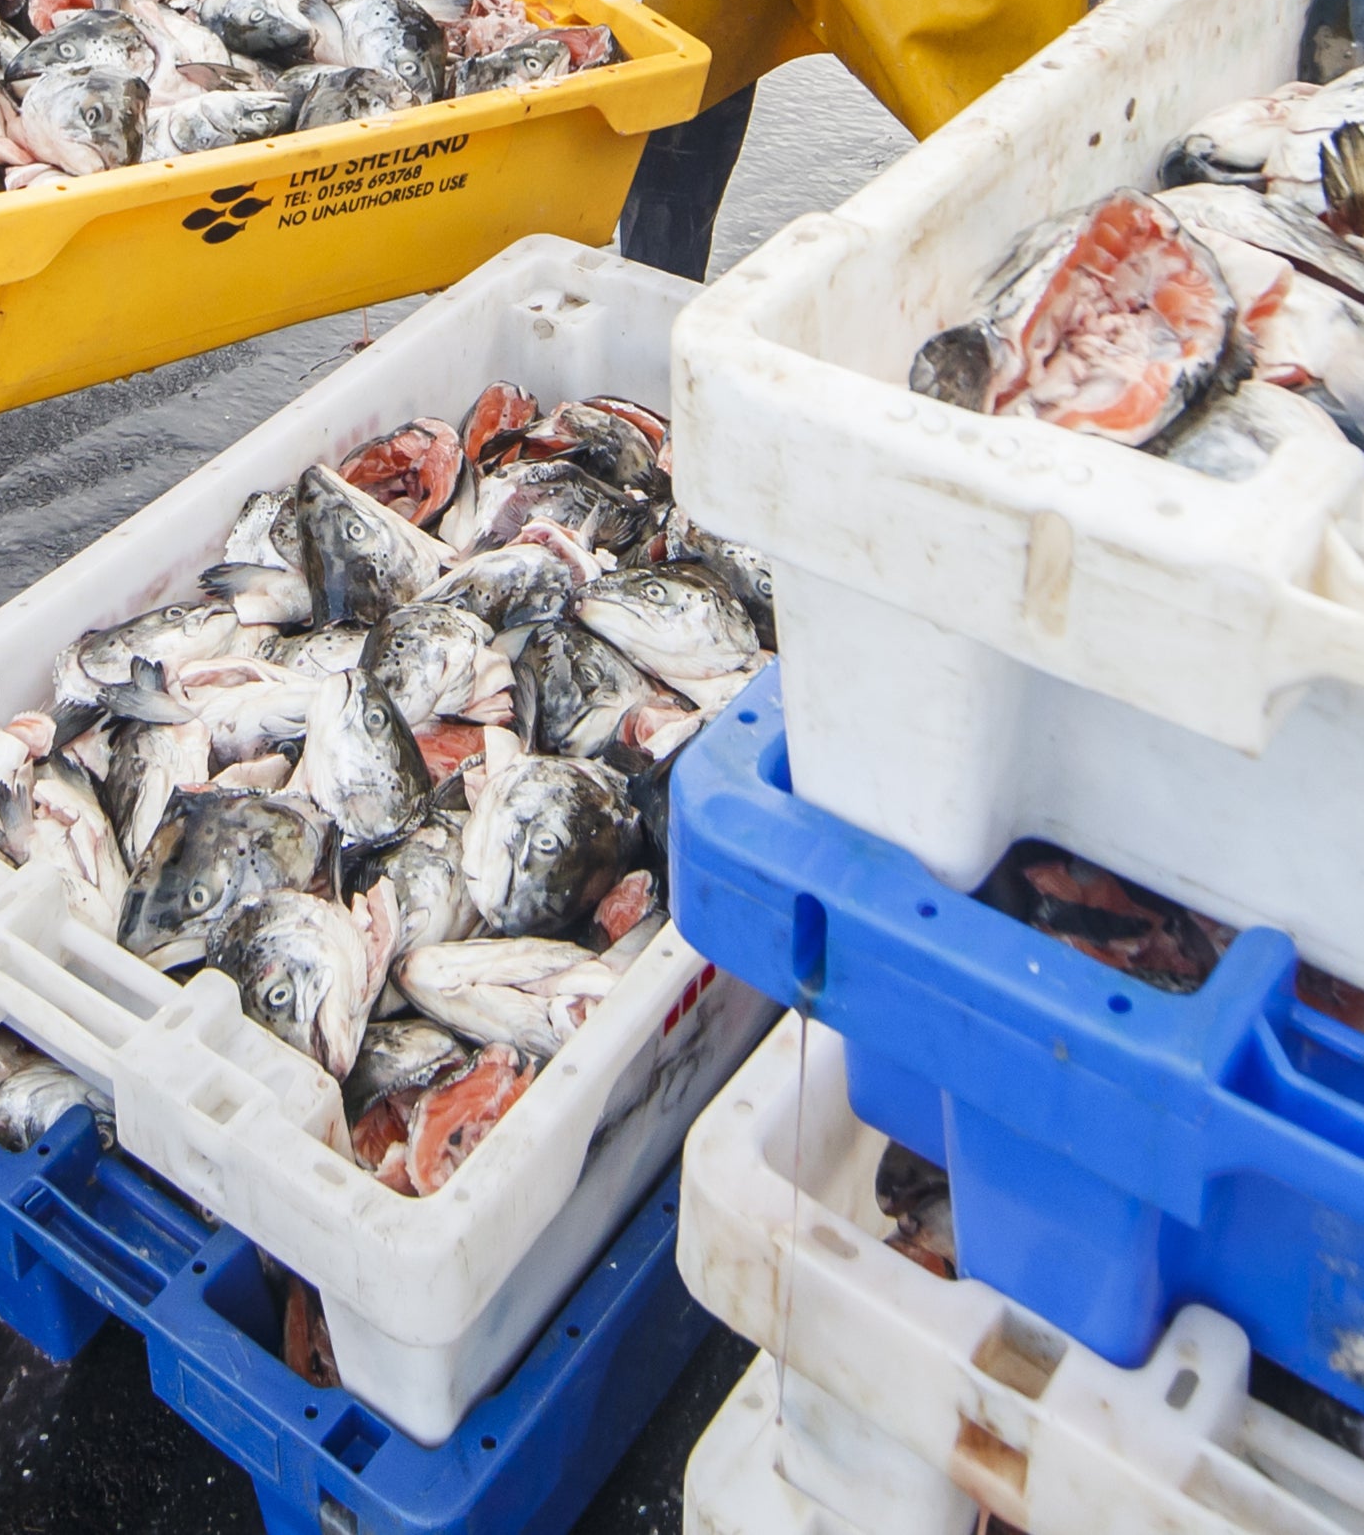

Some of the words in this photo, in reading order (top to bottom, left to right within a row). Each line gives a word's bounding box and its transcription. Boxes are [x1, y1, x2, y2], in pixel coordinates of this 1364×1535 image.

[284, 190, 312, 208] TEL:
[317, 177, 363, 201] 01595
[367, 165, 423, 189] 693768
[289, 163, 338, 188] LHD
[345, 133, 470, 176] SHETLAND
[277, 210, 307, 230] NO
[312, 181, 434, 222] UNAUTHORISED
[439, 173, 469, 193] USE
